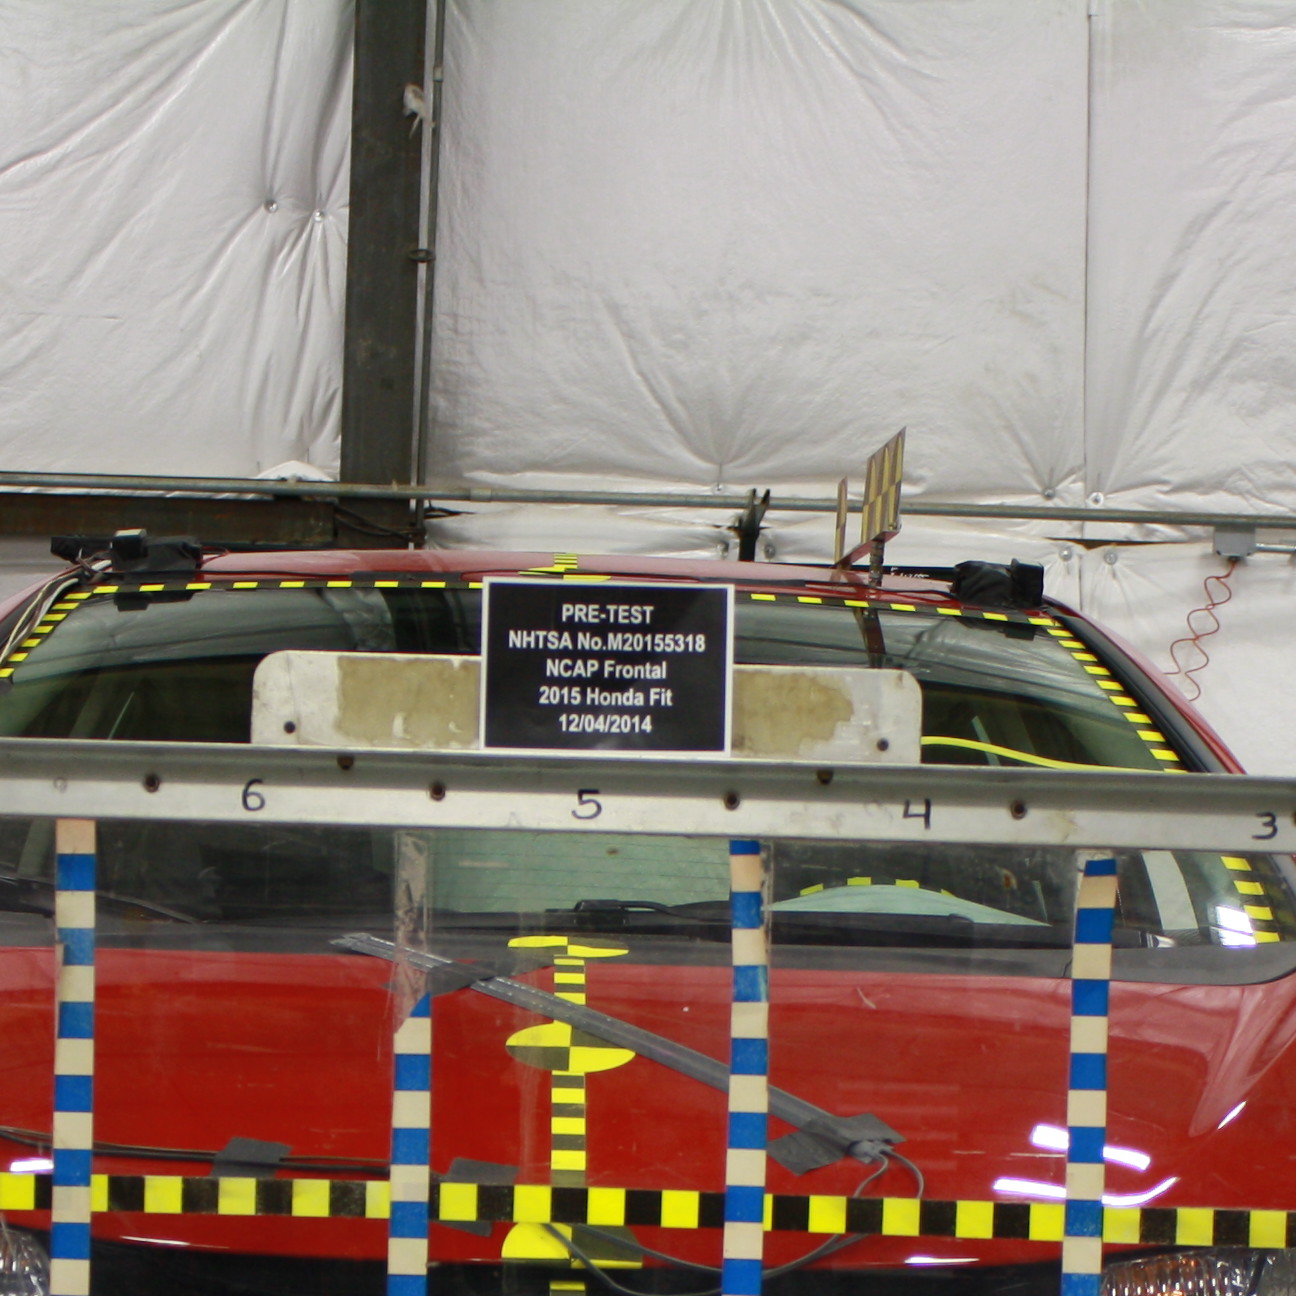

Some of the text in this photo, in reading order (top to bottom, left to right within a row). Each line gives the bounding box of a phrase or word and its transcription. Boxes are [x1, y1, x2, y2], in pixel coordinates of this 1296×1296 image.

[561, 603, 654, 624] PRE-TEST
[508, 630, 705, 652] NHTSA No.M20155318
[545, 659, 667, 679] NCAP Frontal
[538, 686, 673, 706] 2015 Honda Fit
[558, 713, 652, 733] 12/04/2014
[241, 778, 266, 812] 6
[571, 789, 603, 820] 5
[902, 798, 932, 830] 4
[1253, 812, 1279, 840] 3
